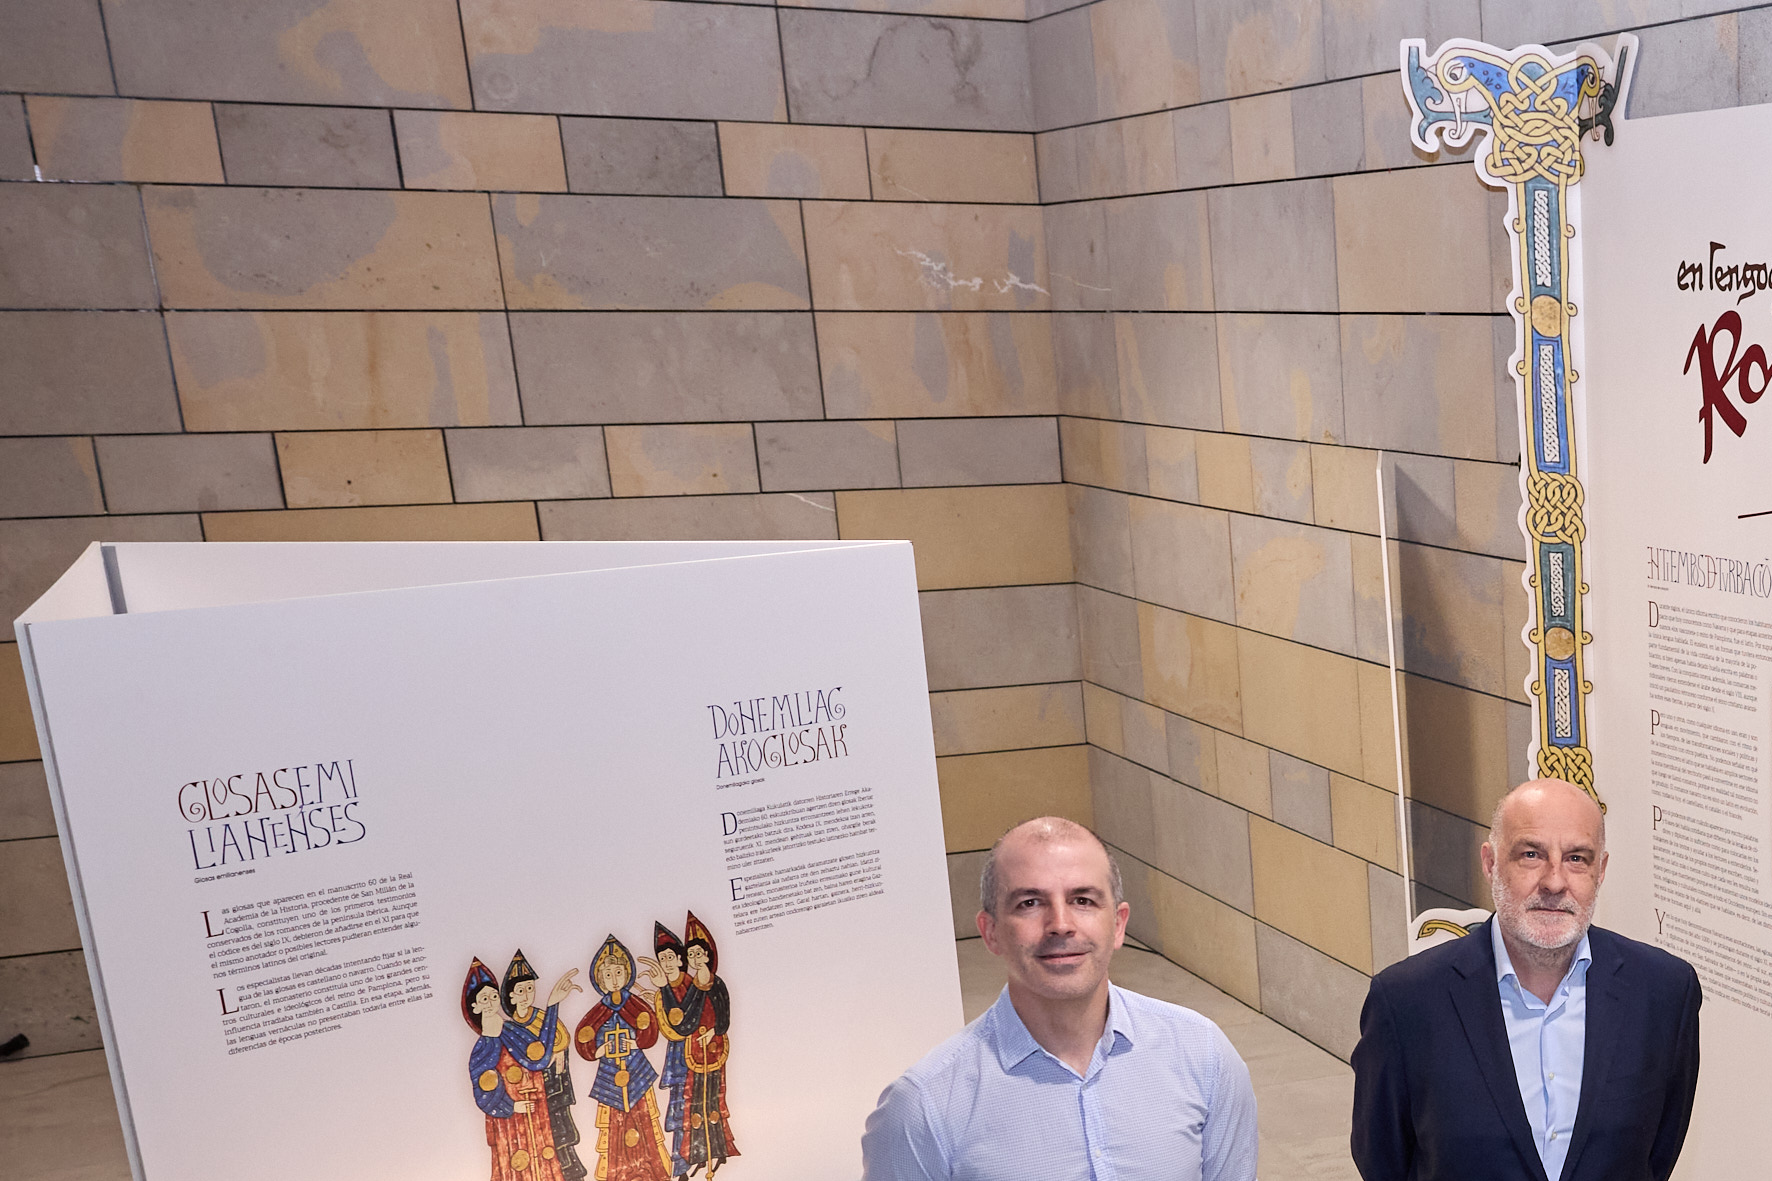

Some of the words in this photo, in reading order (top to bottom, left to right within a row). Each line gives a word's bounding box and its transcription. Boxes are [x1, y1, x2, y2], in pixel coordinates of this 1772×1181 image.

[1677, 260, 1703, 292] en
[223, 912, 258, 924] Academia
[375, 885, 396, 894] Millán
[231, 903, 254, 913] glosas
[256, 900, 270, 908] que
[272, 893, 304, 904] aparecen
[367, 878, 377, 886] 60
[397, 872, 412, 880] Real
[276, 923, 310, 934] romances
[330, 911, 364, 924] península
[391, 901, 417, 911] Aunque
[301, 911, 316, 919] uno
[343, 900, 374, 912] primeros
[217, 947, 240, 956] códice
[250, 941, 262, 949] del
[263, 938, 280, 947] siglo
[292, 930, 323, 941] debieron
[334, 922, 363, 932] añadirse
[390, 914, 405, 923] para
[406, 911, 419, 919] que
[218, 957, 244, 966] mismo
[245, 950, 276, 961] anotador
[284, 942, 313, 954] posibles
[313, 937, 341, 947] lectores
[341, 930, 372, 943] pudieran
[372, 924, 402, 934] entender
[227, 964, 260, 975] términos
[261, 958, 286, 968] latinos
[287, 954, 298, 962] del
[291, 970, 313, 979] llevan
[314, 963, 342, 974] décadas
